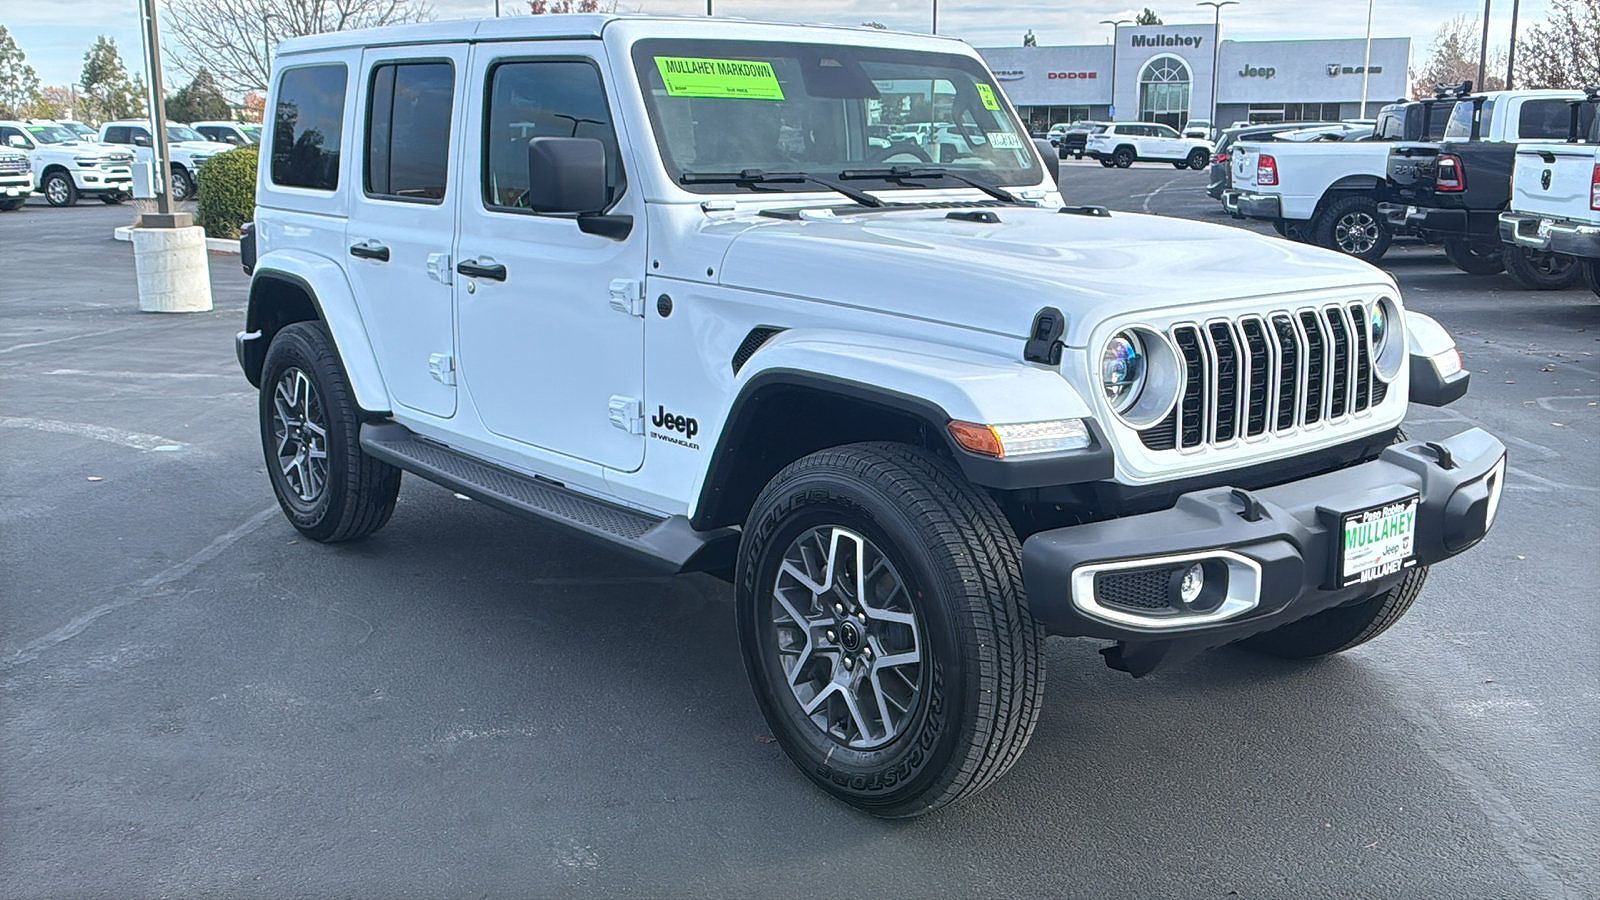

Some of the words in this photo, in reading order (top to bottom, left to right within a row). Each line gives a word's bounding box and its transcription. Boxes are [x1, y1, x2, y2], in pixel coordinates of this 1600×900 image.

[1131, 35, 1202, 49] Mullahey
[666, 60, 715, 75] MULLAHEY
[717, 63, 772, 78] MARKDOWN
[1239, 64, 1275, 78] Jeep
[652, 405, 698, 440] Jeep
[657, 434, 700, 450] WRANGLER
[1363, 510, 1382, 523] Paso
[1382, 503, 1405, 517] Robles
[1345, 510, 1413, 550] MULLAHEY
[1382, 544, 1399, 556] Jeep
[1361, 558, 1403, 583] MULLAHEY
